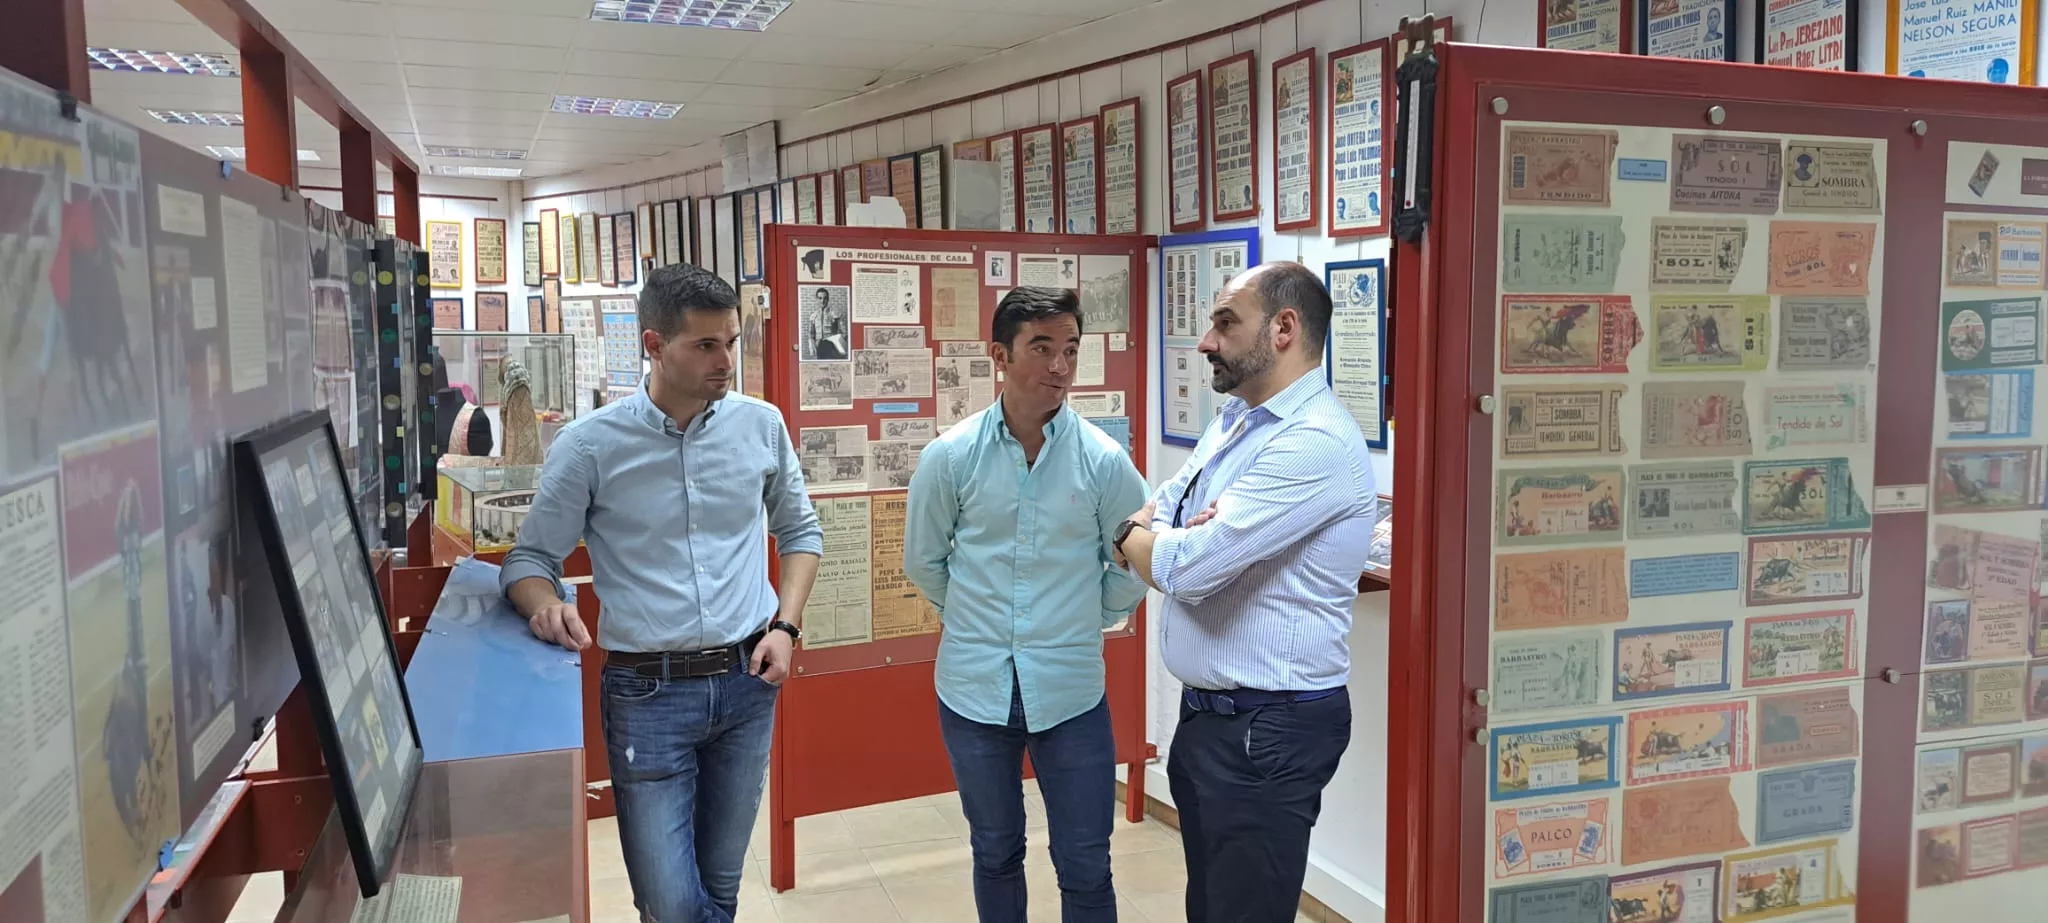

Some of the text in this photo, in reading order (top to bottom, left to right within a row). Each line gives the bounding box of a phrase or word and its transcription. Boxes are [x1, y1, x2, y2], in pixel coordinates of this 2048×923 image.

[1904, 10, 1941, 26] Manuel
[1946, 7, 1968, 20] Ruiz
[1794, 14, 1843, 47] JEREZANO
[1904, 14, 2016, 43] NELSON SEGURA
[1818, 40, 1842, 64] LITRI
[1822, 176, 1865, 188] SOMBRA
[857, 252, 925, 261] PROFESIONALES
[1666, 258, 1705, 267] SOL
[1806, 260, 1826, 271] SOL
[1554, 409, 1581, 420] SOMBRA
[1732, 400, 1742, 439] SOL
[1776, 415, 1842, 430] Tendido de Sol
[1540, 431, 1595, 443] TENDIDO GENERAL
[1688, 472, 1733, 480] BARBASTRO
[1801, 490, 1823, 499] SOL
[1996, 576, 2017, 585] EDAD
[1679, 640, 1722, 649] BARBASTRO
[1500, 654, 1547, 664] BARBASTRO
[1782, 806, 1823, 818] GRADA
[1531, 828, 1572, 844] PALCO
